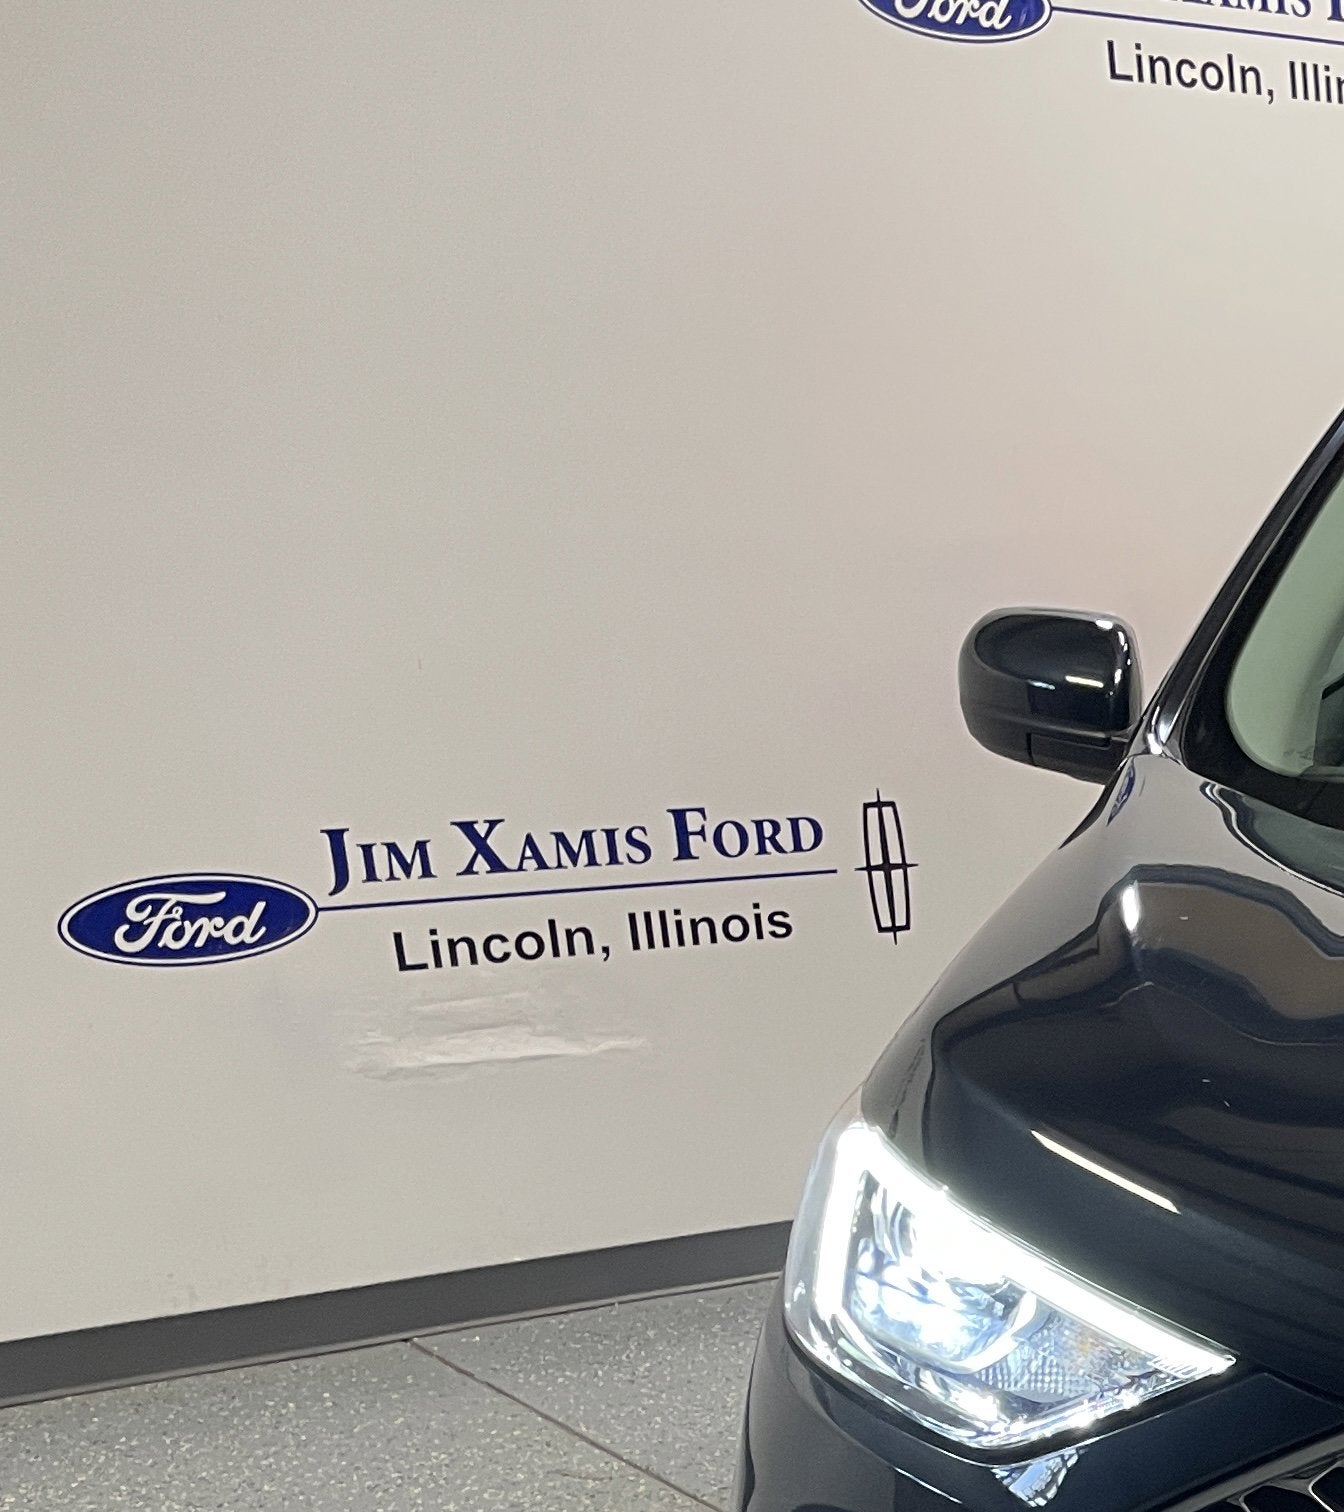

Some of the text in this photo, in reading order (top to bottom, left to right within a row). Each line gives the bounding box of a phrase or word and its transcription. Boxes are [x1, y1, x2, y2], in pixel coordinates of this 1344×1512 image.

[1105, 39, 1275, 106] Lincoln,
[319, 806, 824, 897] JIM XAMIS FORD
[392, 901, 794, 973] Lincoln, Illinois
